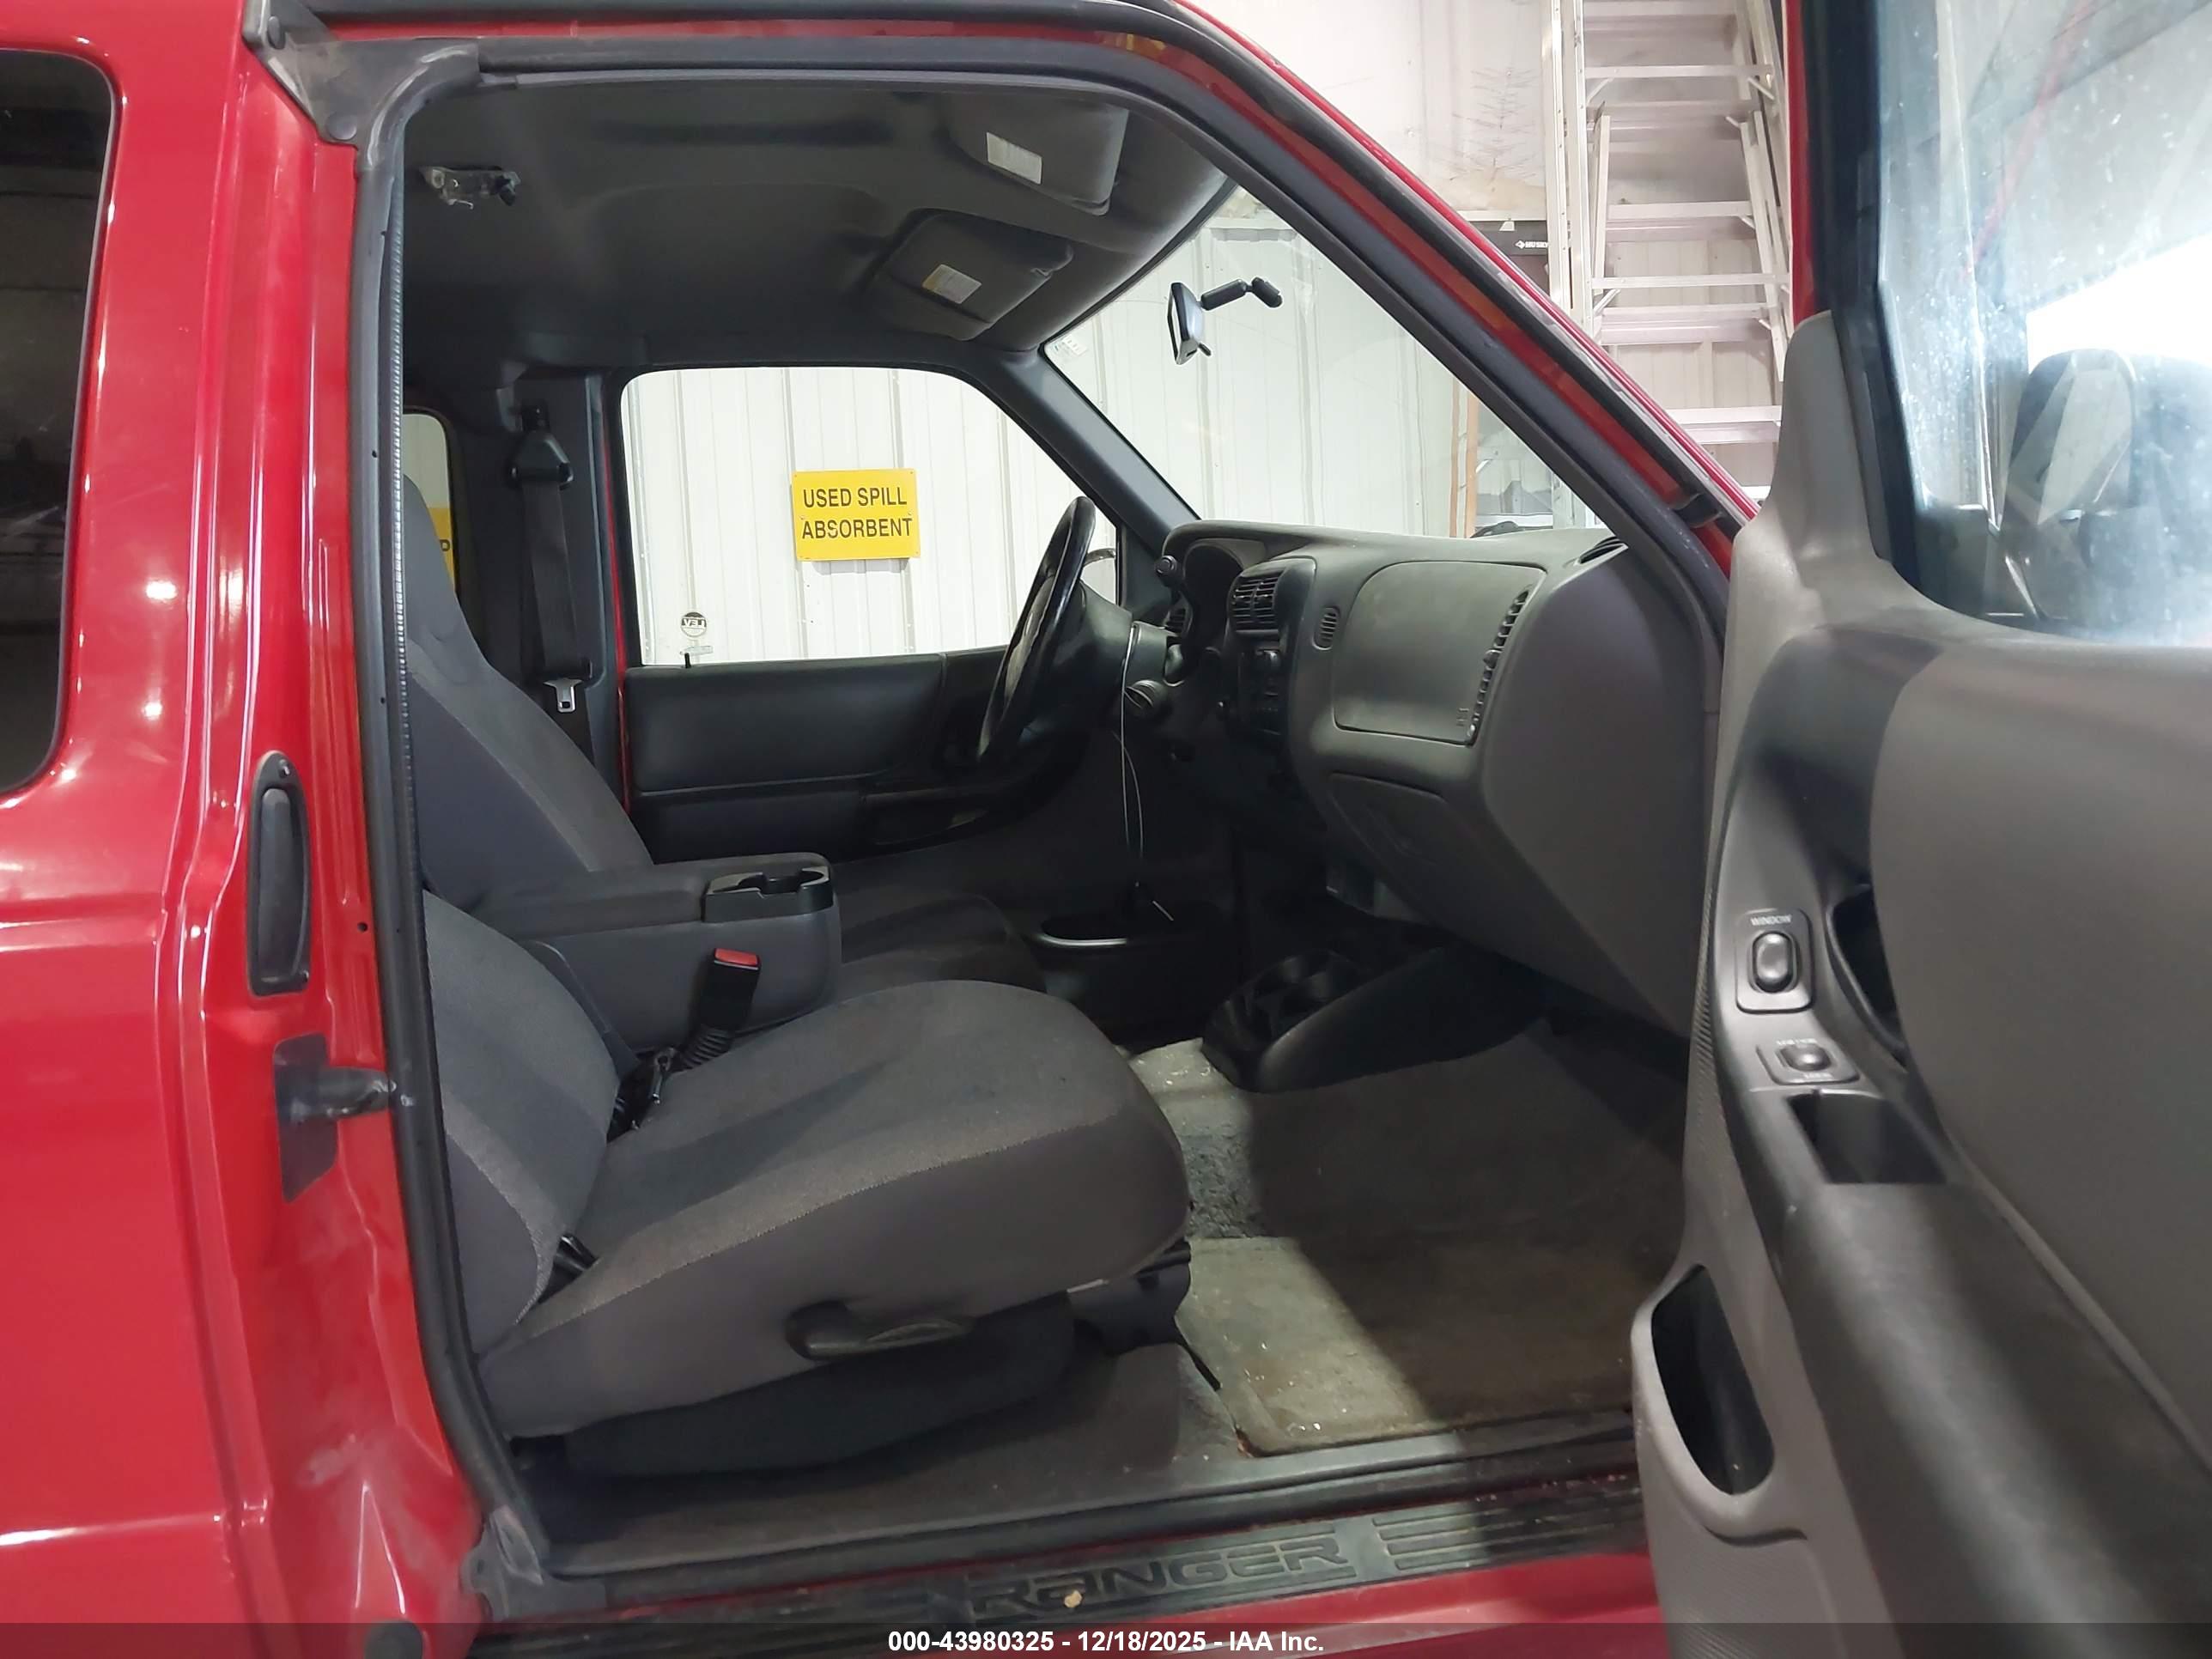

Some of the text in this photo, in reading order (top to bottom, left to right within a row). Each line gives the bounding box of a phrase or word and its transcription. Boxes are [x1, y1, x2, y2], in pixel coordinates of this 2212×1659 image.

[804, 487, 908, 507] USED SPILL
[802, 518, 913, 539] ABSORBENT
[970, 1535, 1349, 1613] RANGER
